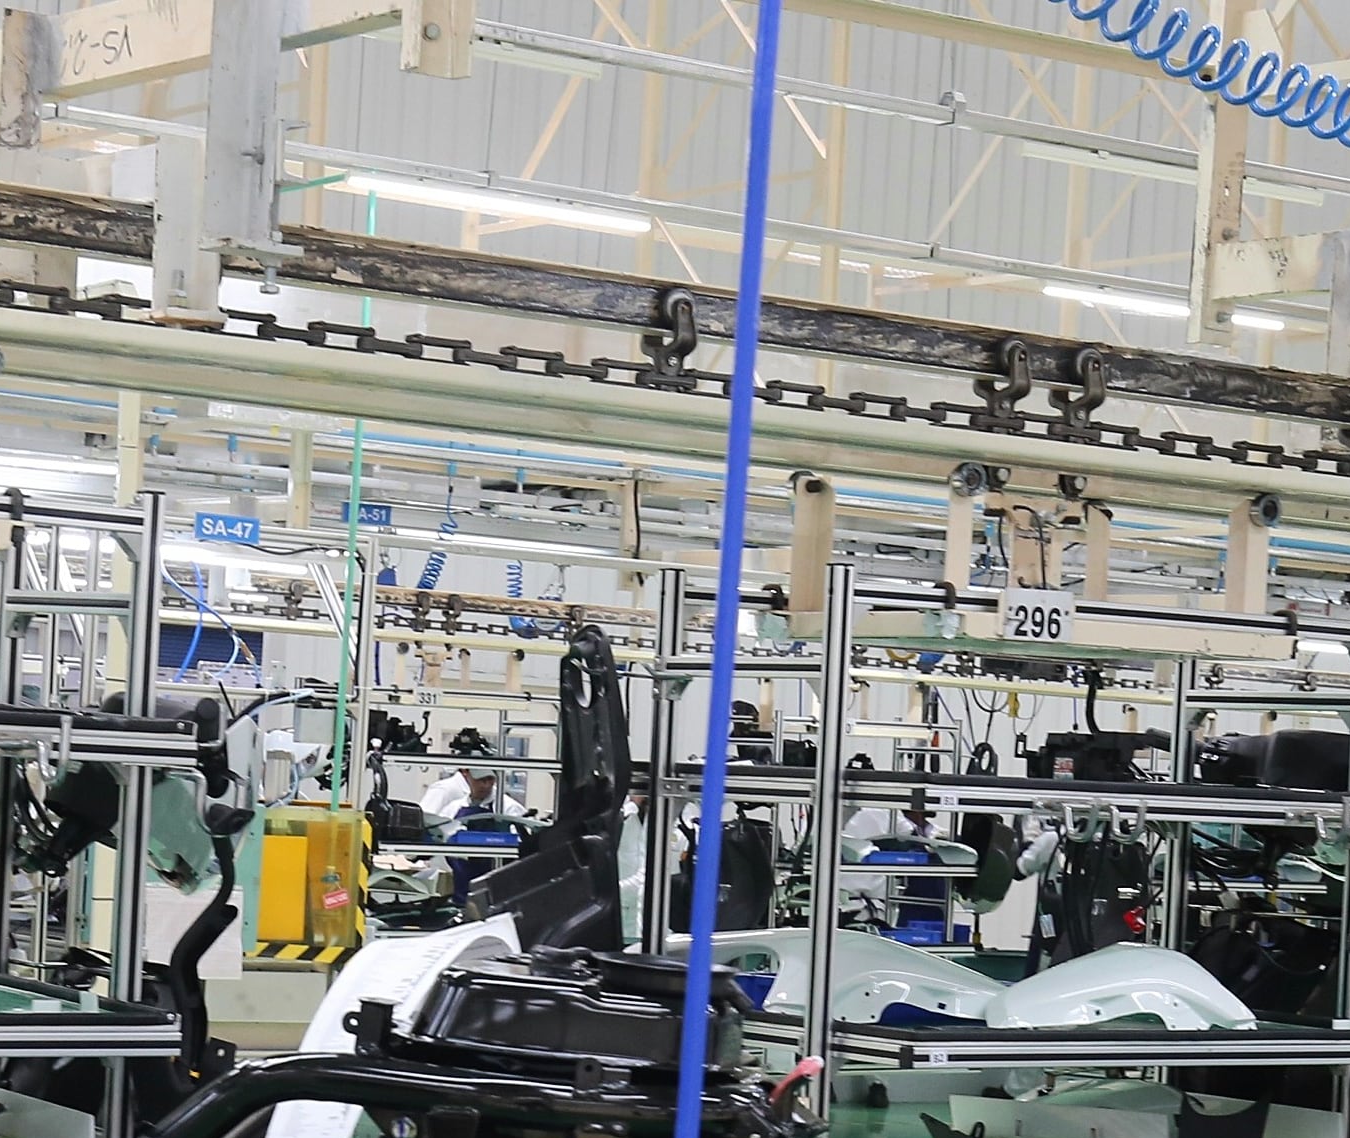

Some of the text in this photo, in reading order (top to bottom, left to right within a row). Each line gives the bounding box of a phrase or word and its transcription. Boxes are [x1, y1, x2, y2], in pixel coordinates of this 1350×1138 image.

[357, 508, 387, 522] A-51
[202, 518, 254, 539] SA-47
[1014, 605, 1062, 639] 296
[418, 691, 437, 704] 331
